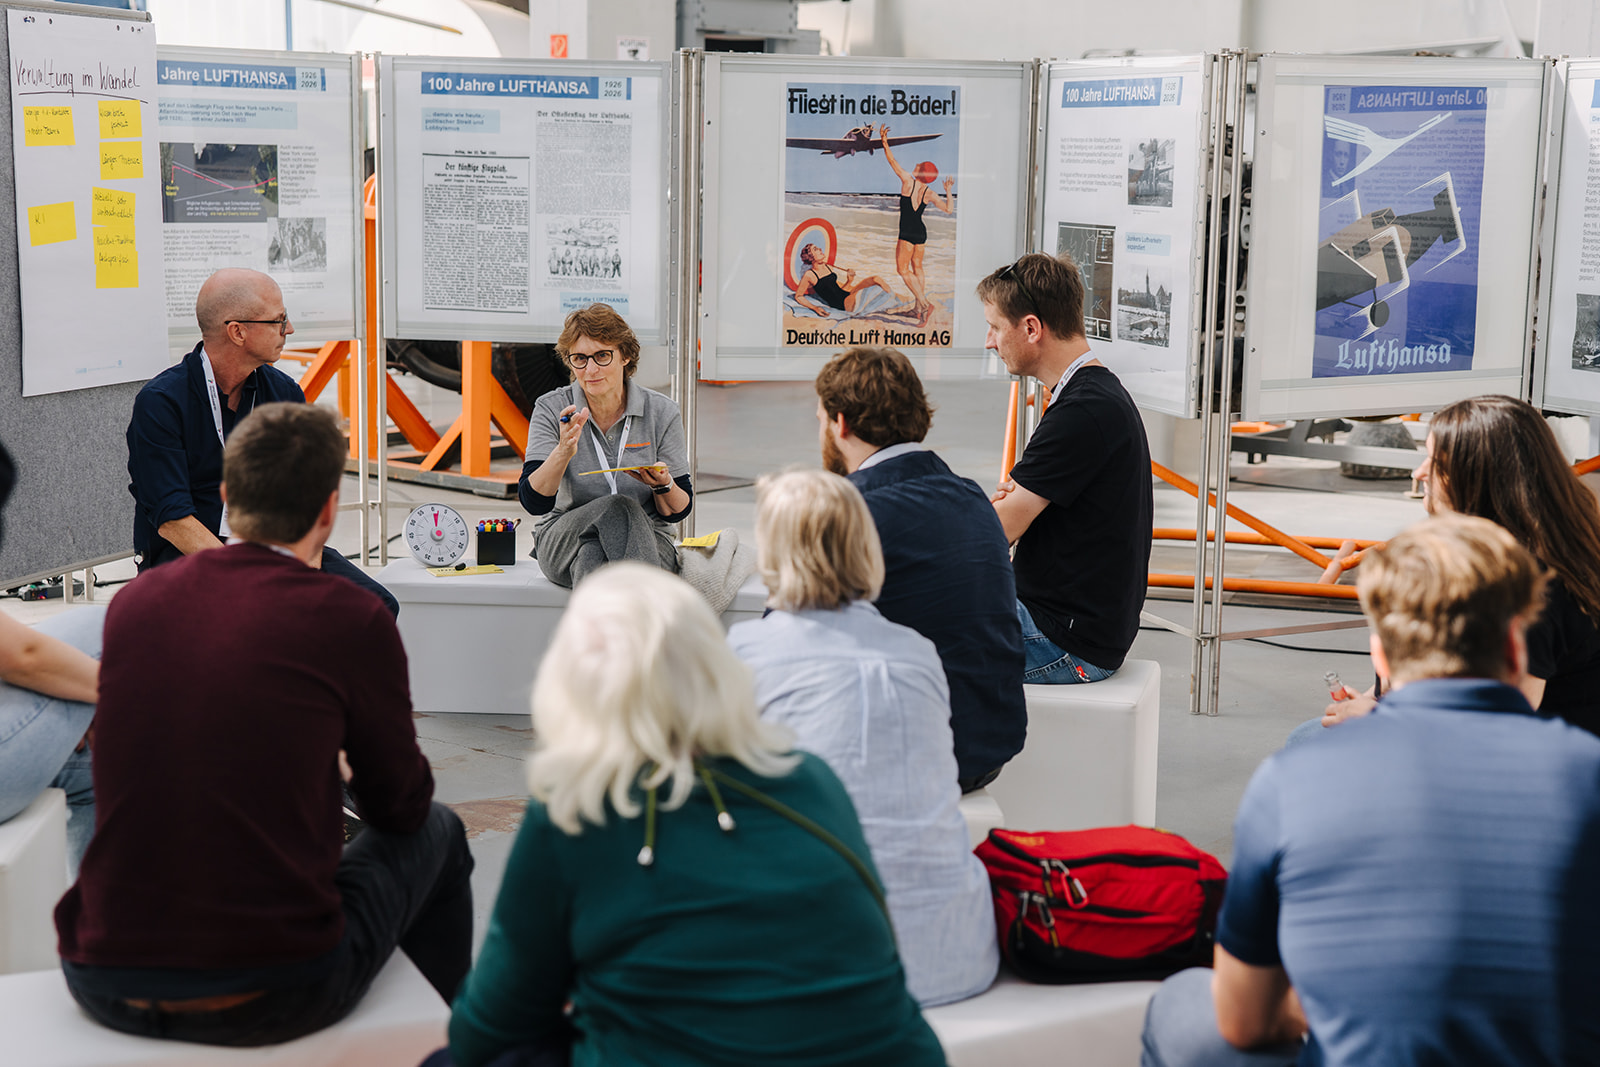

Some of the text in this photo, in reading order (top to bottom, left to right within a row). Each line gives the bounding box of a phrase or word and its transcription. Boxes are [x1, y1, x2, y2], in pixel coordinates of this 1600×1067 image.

[15, 58, 140, 97] Verwaltung im Wandel
[161, 67, 288, 85] Jahre LUFTHANSA
[428, 77, 589, 94] 100 Jahre LUFTHANSA
[1066, 85, 1155, 102] 100 Jahre LUFTHANSA
[788, 88, 956, 115] Fliegt in die Bäder!
[786, 329, 950, 345] Deutsche Luft Hansa AG
[1334, 338, 1451, 374] Lufthansa
